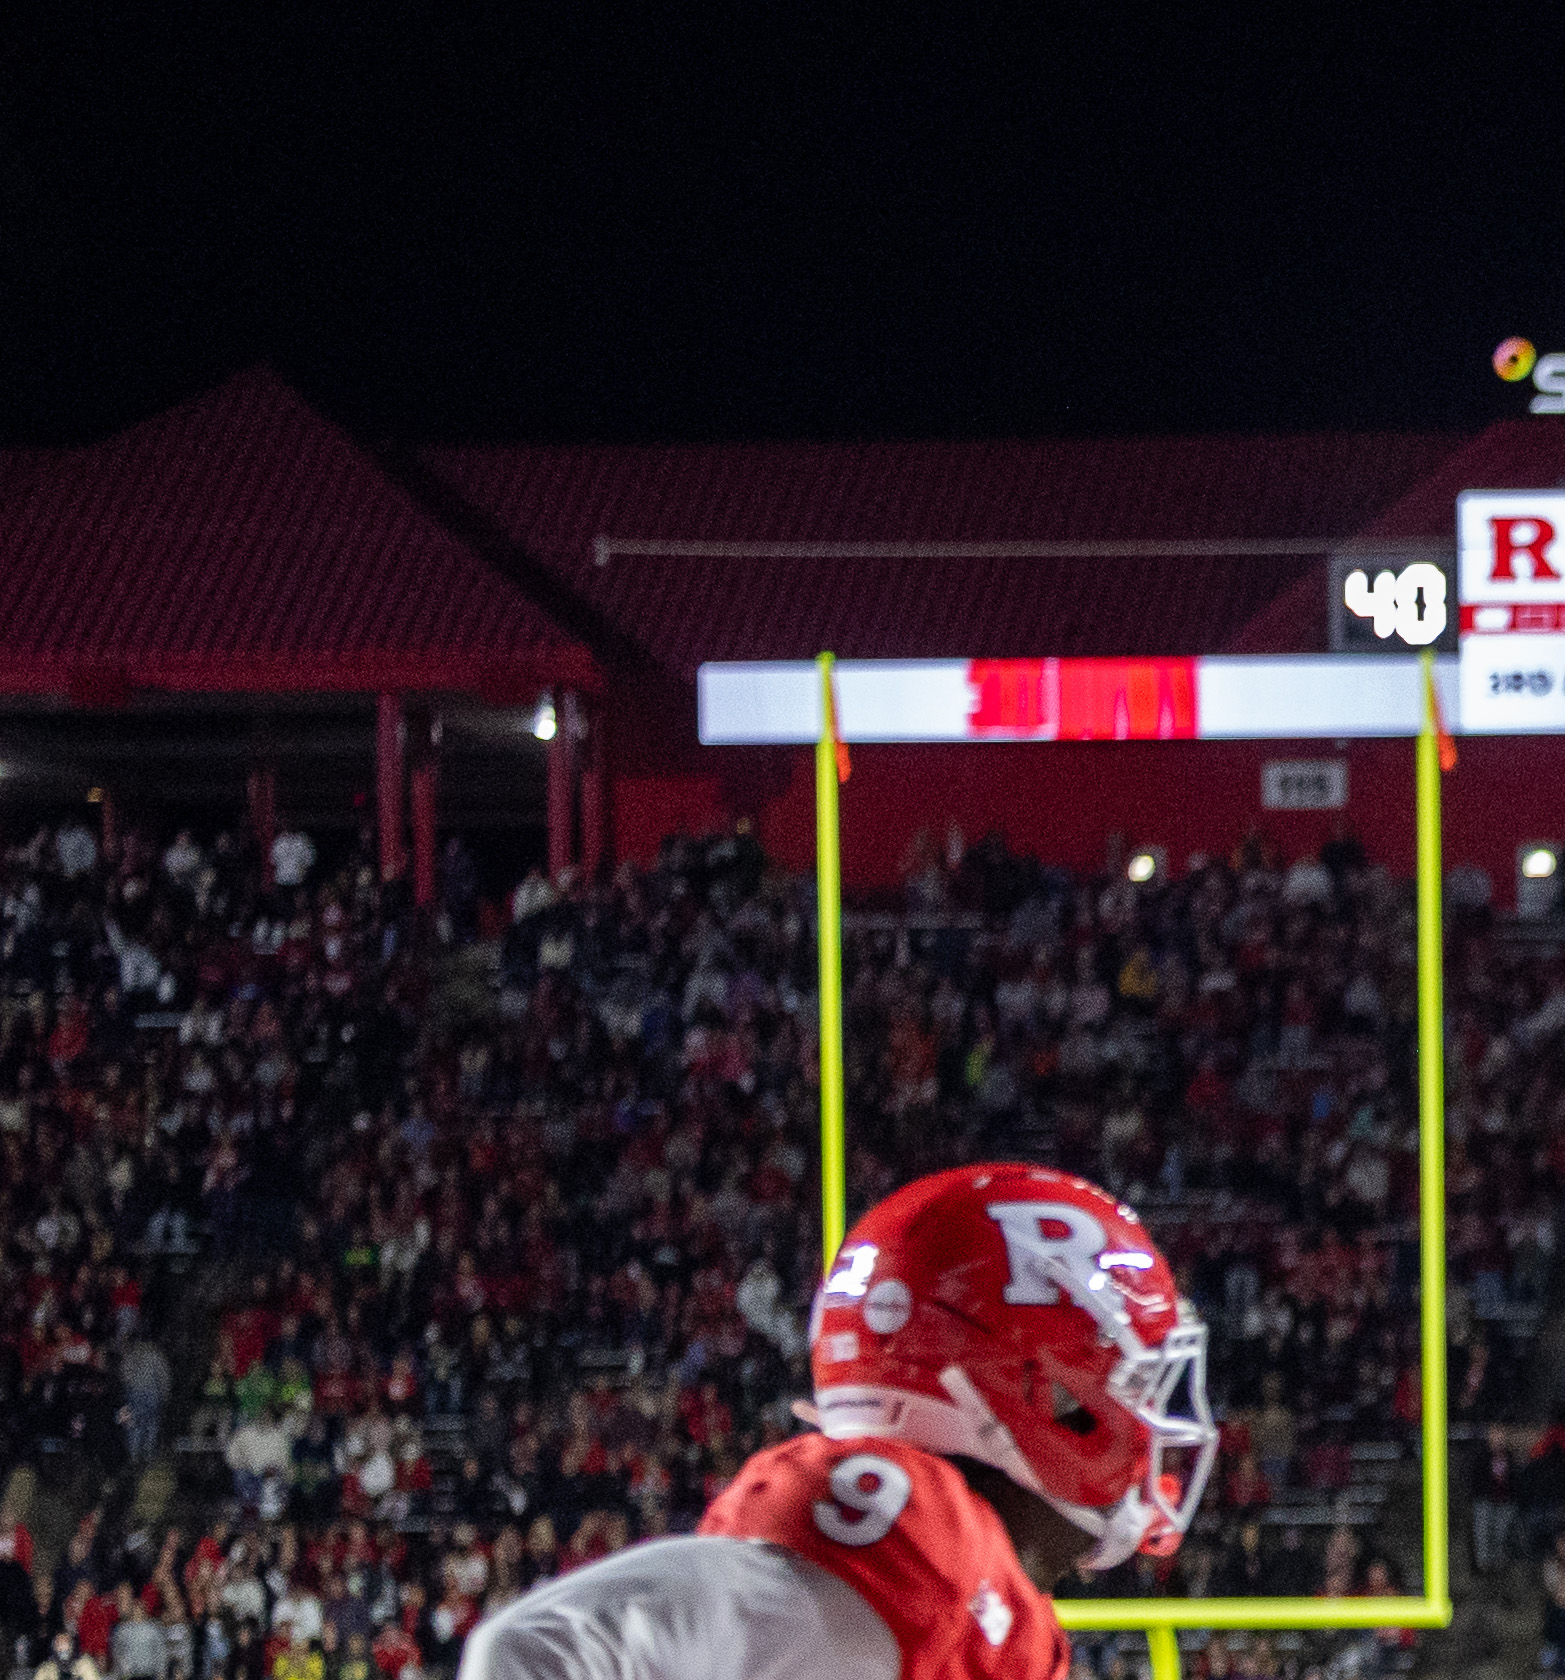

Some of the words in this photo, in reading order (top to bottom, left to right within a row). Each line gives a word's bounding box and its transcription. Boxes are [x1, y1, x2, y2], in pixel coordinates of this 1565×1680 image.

[1489, 517, 1563, 583] R
[1343, 561, 1447, 646] 40
[985, 1201, 1122, 1306] R
[812, 1453, 912, 1547] 9
